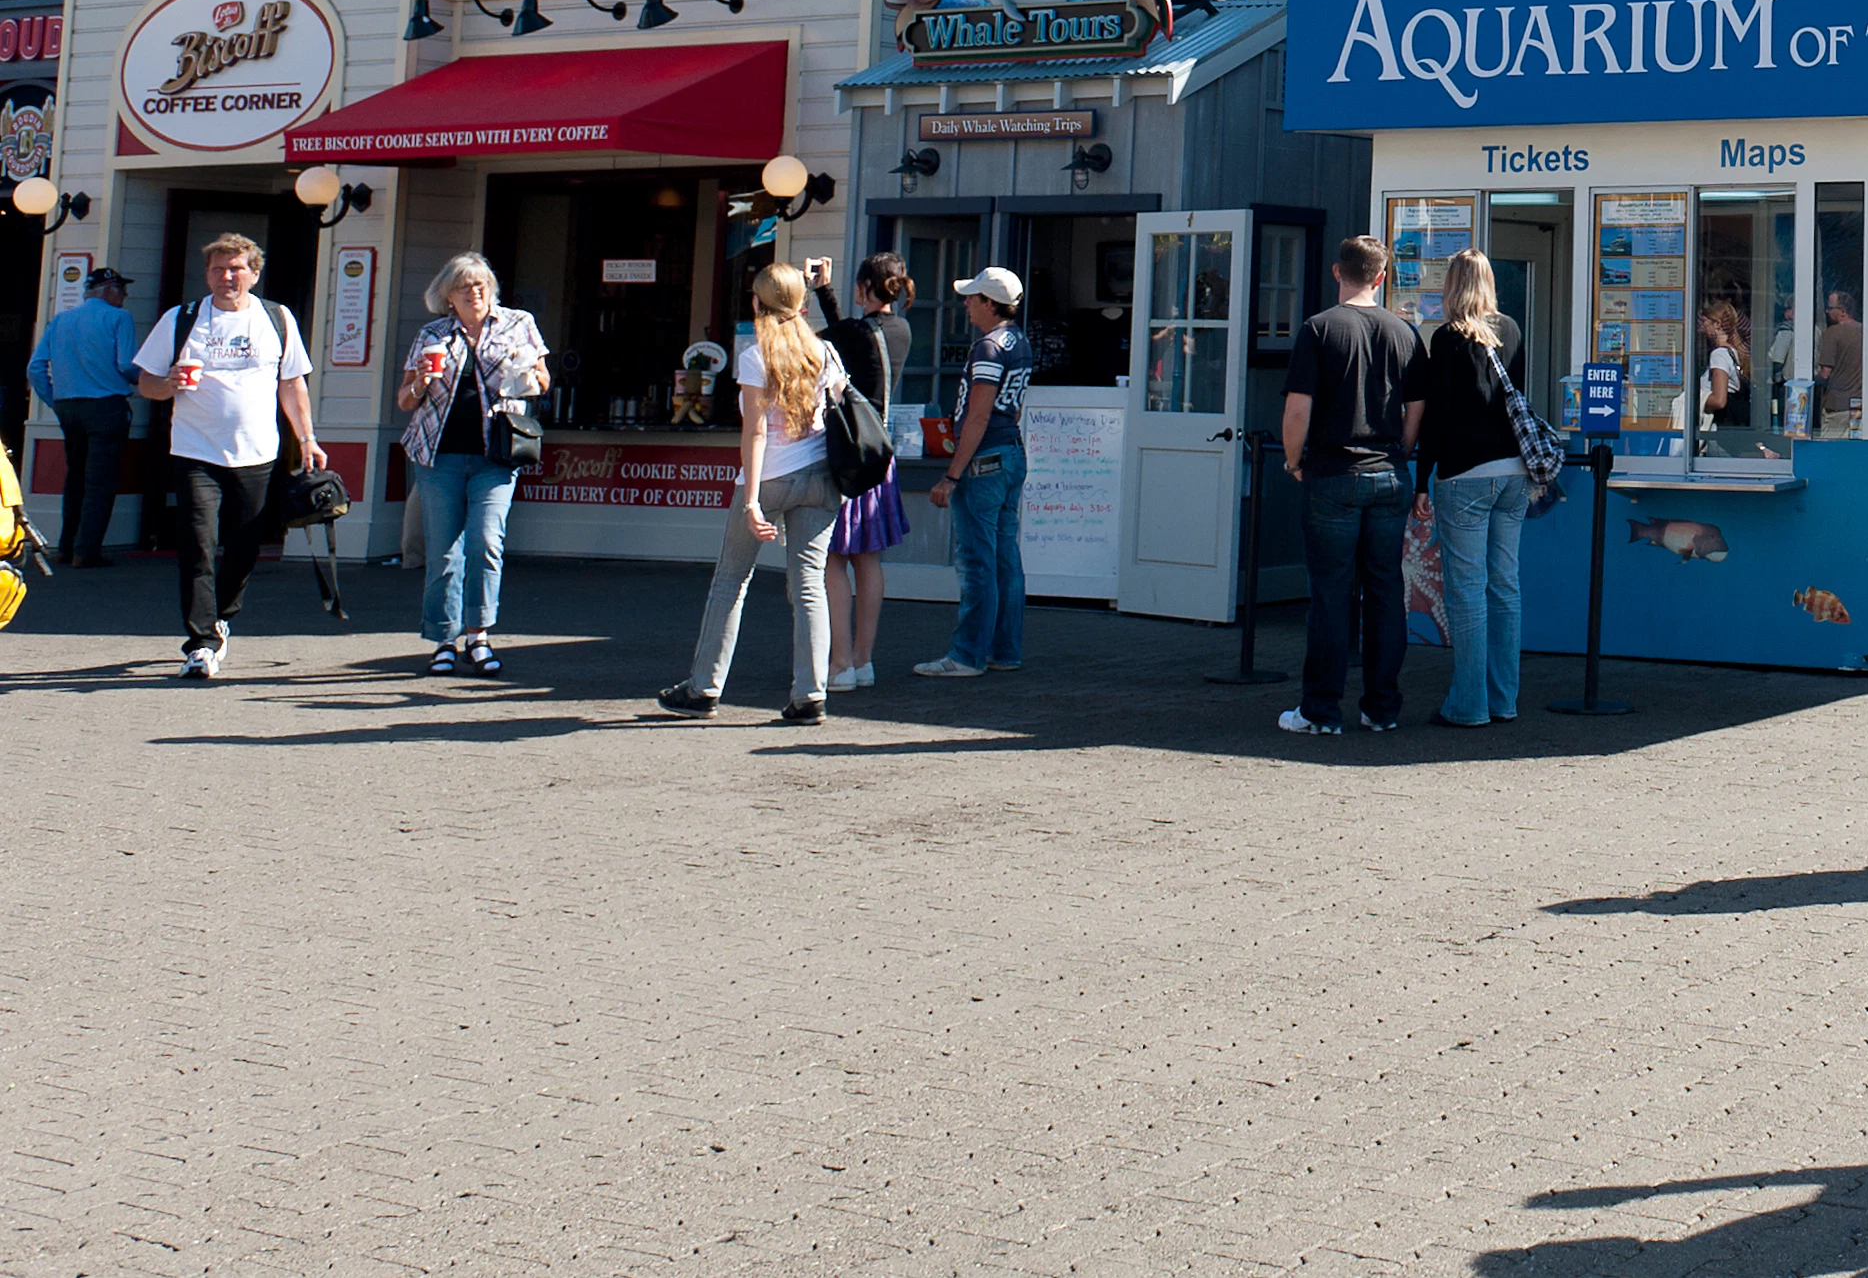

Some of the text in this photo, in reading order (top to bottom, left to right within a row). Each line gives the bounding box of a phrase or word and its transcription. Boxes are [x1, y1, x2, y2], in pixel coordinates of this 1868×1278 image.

[922, 9, 1122, 50] Whale Tours
[158, 1, 290, 95] Biscoff
[1789, 24, 1853, 67] OF
[144, 92, 302, 114] COFFEE CORNER
[293, 124, 608, 152] FREE BISCOFF COOKIE SERVED WITH EVERY COFFEE
[932, 117, 1082, 136] Daily Whale Watching Trips
[1482, 144, 1590, 173] Tickets
[1720, 138, 1806, 173] Maps
[206, 336, 225, 347] SAN
[1587, 369, 1618, 382] ENTER
[1589, 386, 1614, 399] HERE
[543, 448, 622, 484] Biscoff
[621, 463, 677, 480] COOKIE
[680, 465, 735, 482] SERVED
[523, 485, 723, 507] WITH EVERY CUP OF COFFEE
